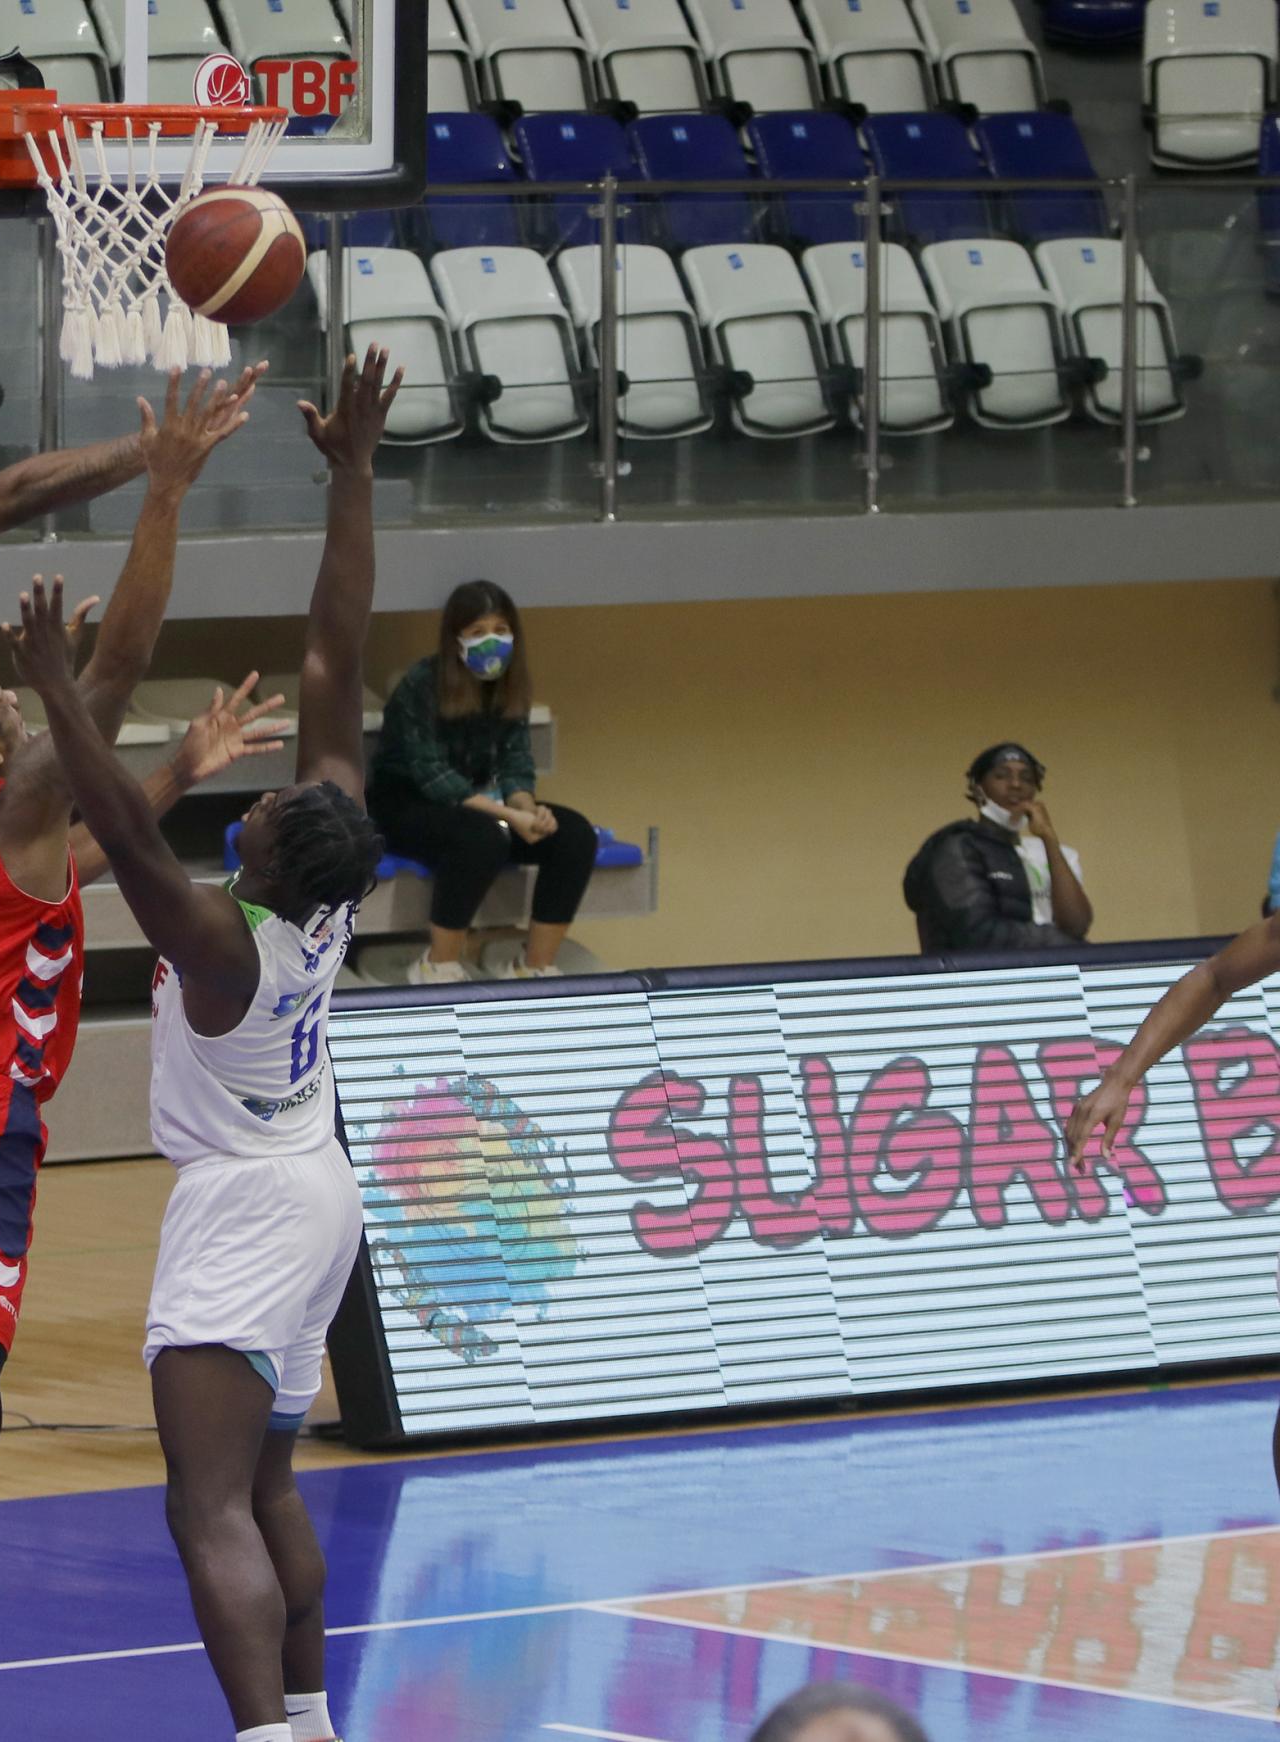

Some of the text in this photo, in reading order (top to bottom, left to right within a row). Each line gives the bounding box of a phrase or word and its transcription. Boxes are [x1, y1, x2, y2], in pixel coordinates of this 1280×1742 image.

[255, 60, 359, 117] TBF
[289, 992, 325, 1085] 6
[606, 1034, 1168, 1260] SUGAR
